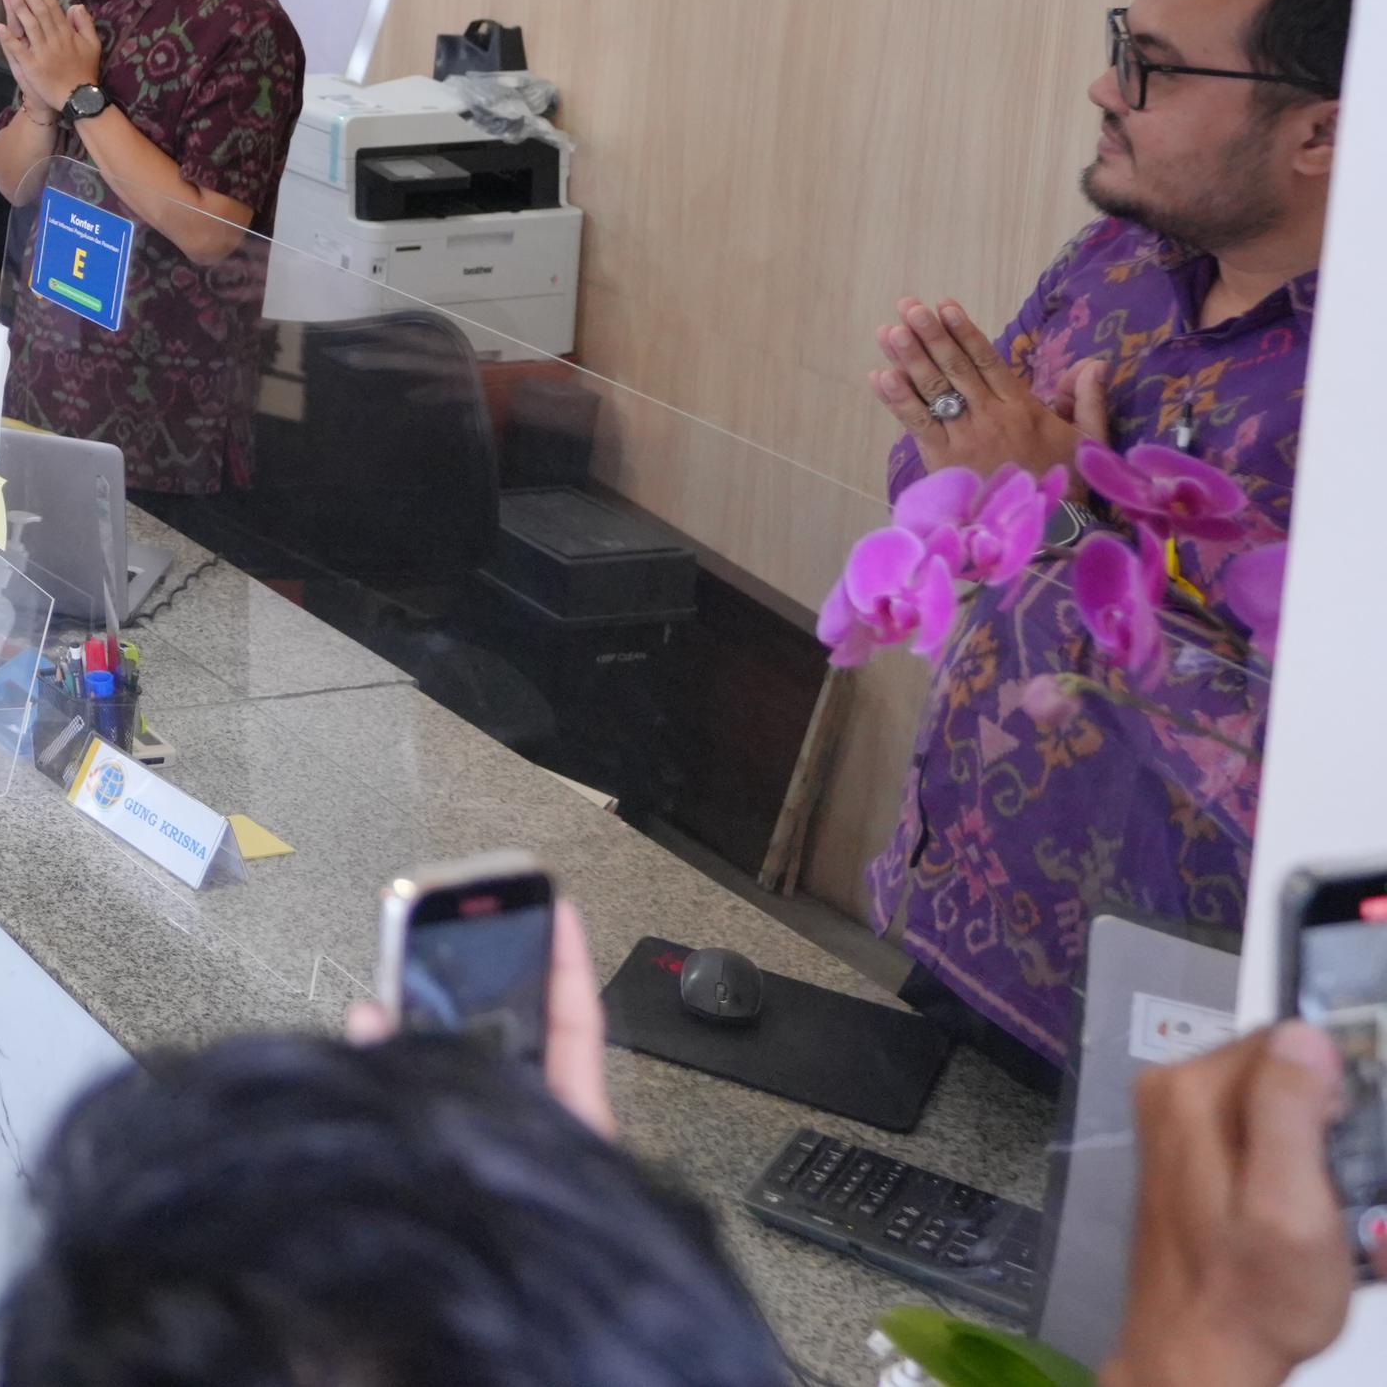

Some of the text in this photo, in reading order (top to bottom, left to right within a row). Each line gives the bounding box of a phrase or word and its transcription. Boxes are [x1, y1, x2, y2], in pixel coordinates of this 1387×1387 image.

[70, 213, 101, 235] Konter E
[72, 247, 88, 280] E
[124, 797, 207, 860] GUNG KRISNA
